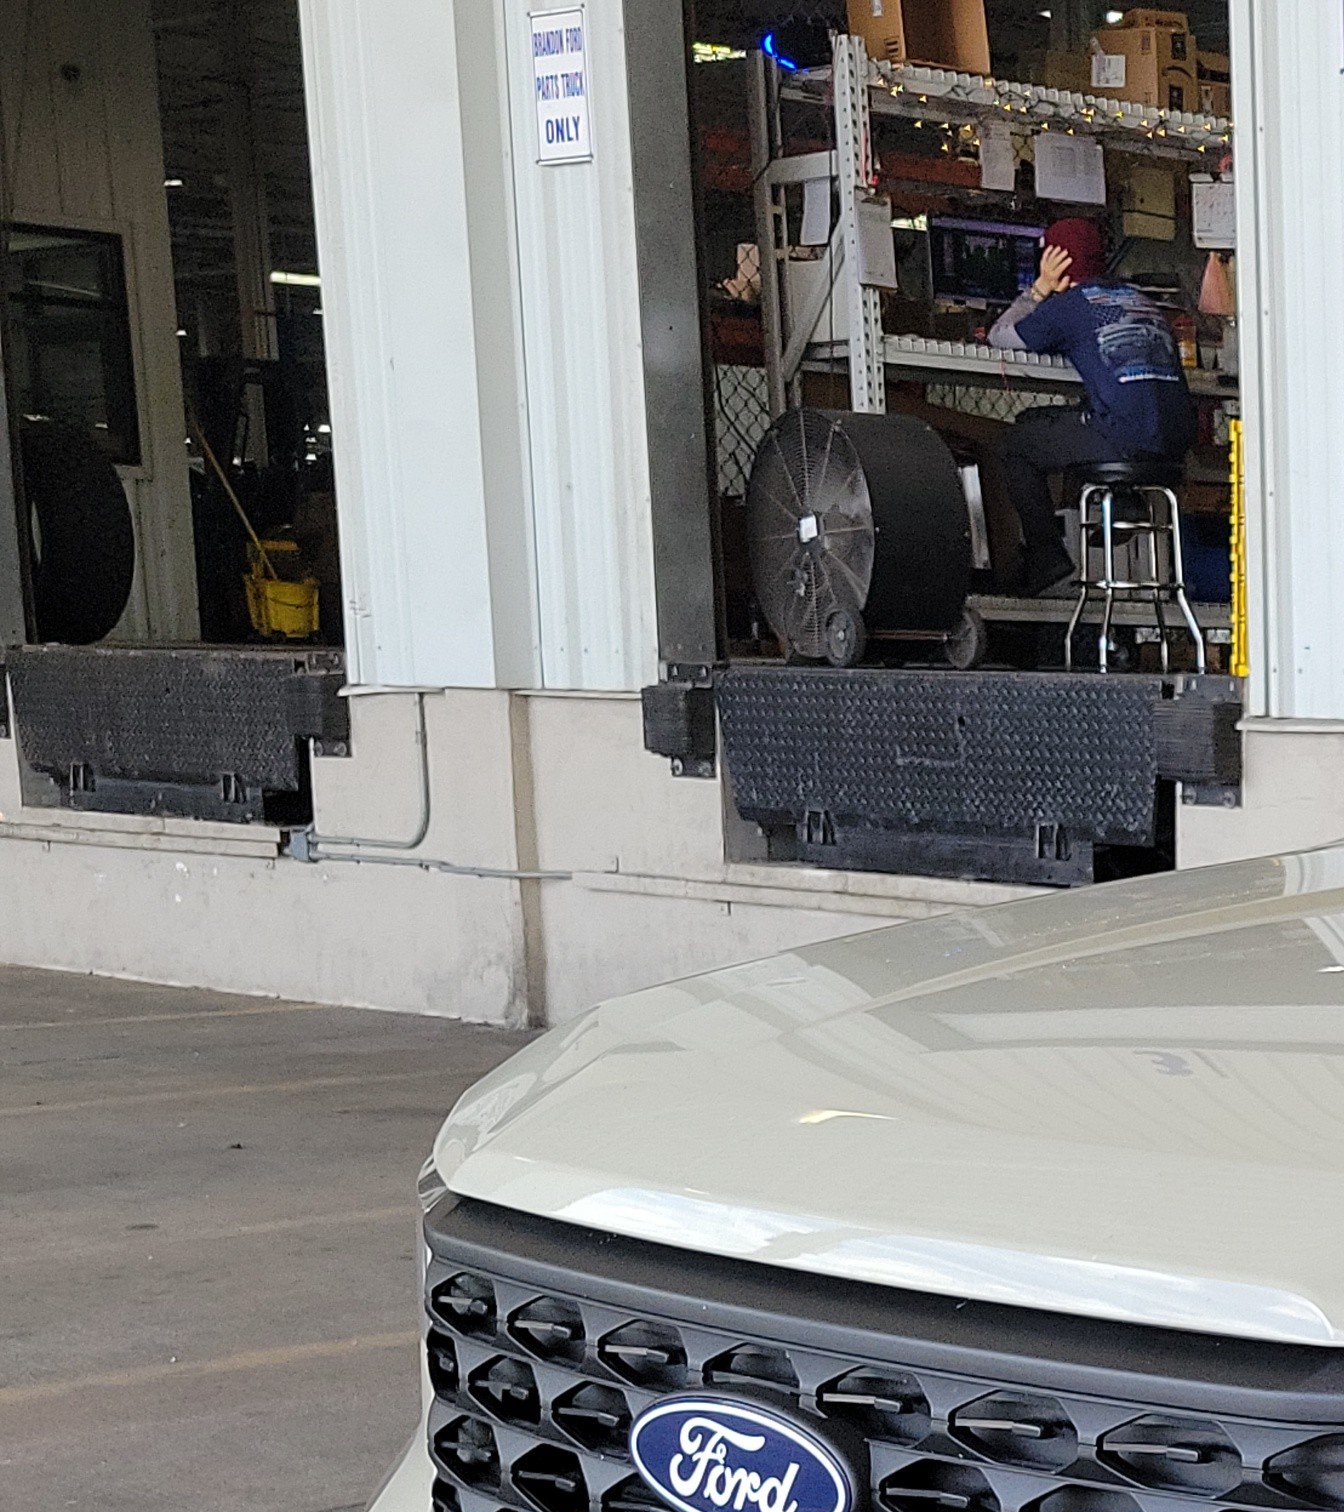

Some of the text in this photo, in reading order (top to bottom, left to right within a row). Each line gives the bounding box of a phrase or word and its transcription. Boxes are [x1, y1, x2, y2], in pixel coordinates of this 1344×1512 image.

[533, 26, 583, 57] BRANDON FORD
[536, 71, 585, 101] PARTS TRUCK
[545, 116, 581, 144] ONLY
